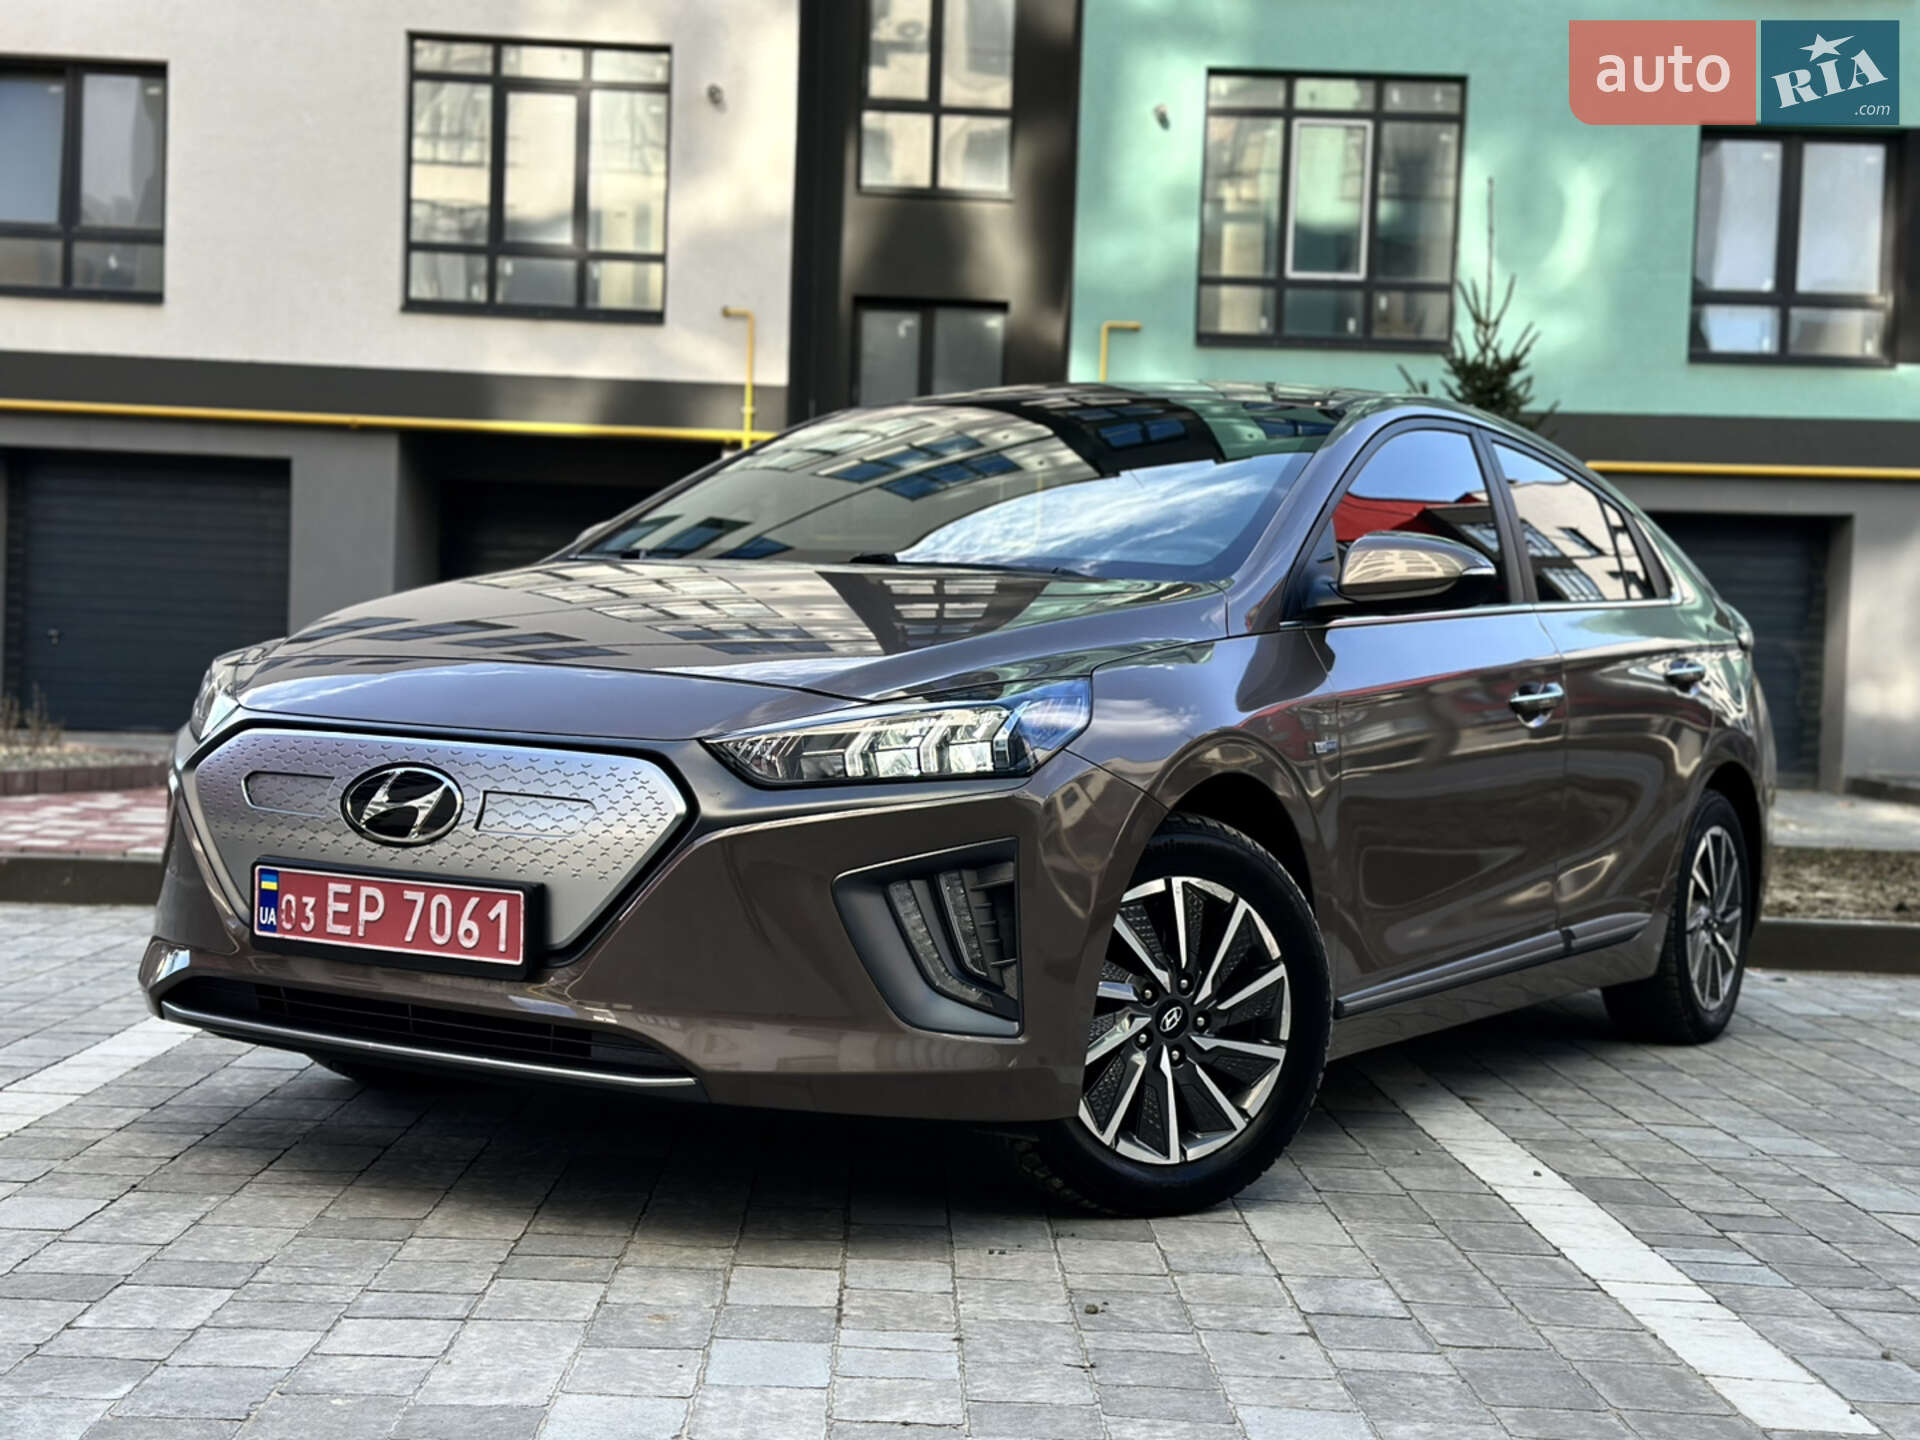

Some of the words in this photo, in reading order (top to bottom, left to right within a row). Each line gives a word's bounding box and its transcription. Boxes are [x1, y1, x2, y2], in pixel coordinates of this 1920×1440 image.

[259, 906, 277, 926] UA
[281, 893, 316, 932] 03
[325, 882, 385, 937] EP
[402, 889, 508, 952] 7061
